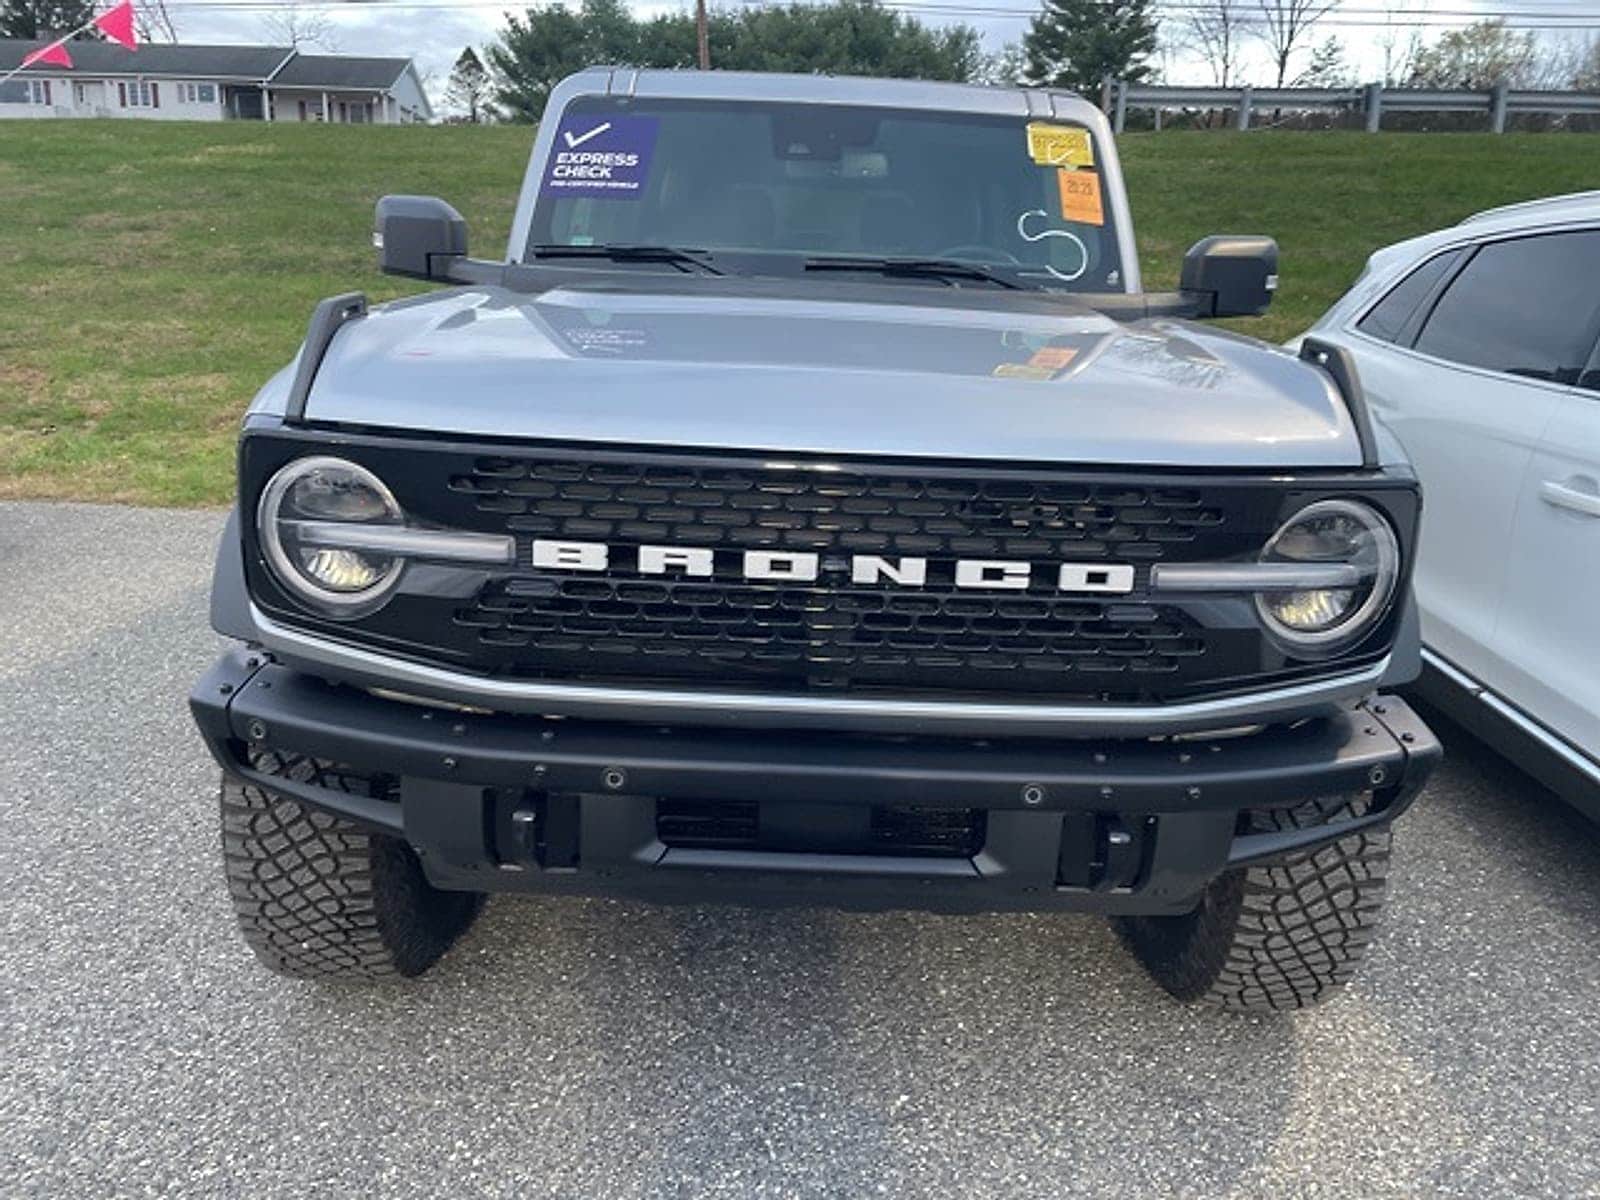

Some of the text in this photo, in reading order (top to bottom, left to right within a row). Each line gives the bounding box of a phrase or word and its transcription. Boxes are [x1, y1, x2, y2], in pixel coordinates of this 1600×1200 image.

[556, 152, 639, 166] EXPRESS
[552, 165, 612, 178] CHECK
[532, 539, 1134, 592] BRONCO
